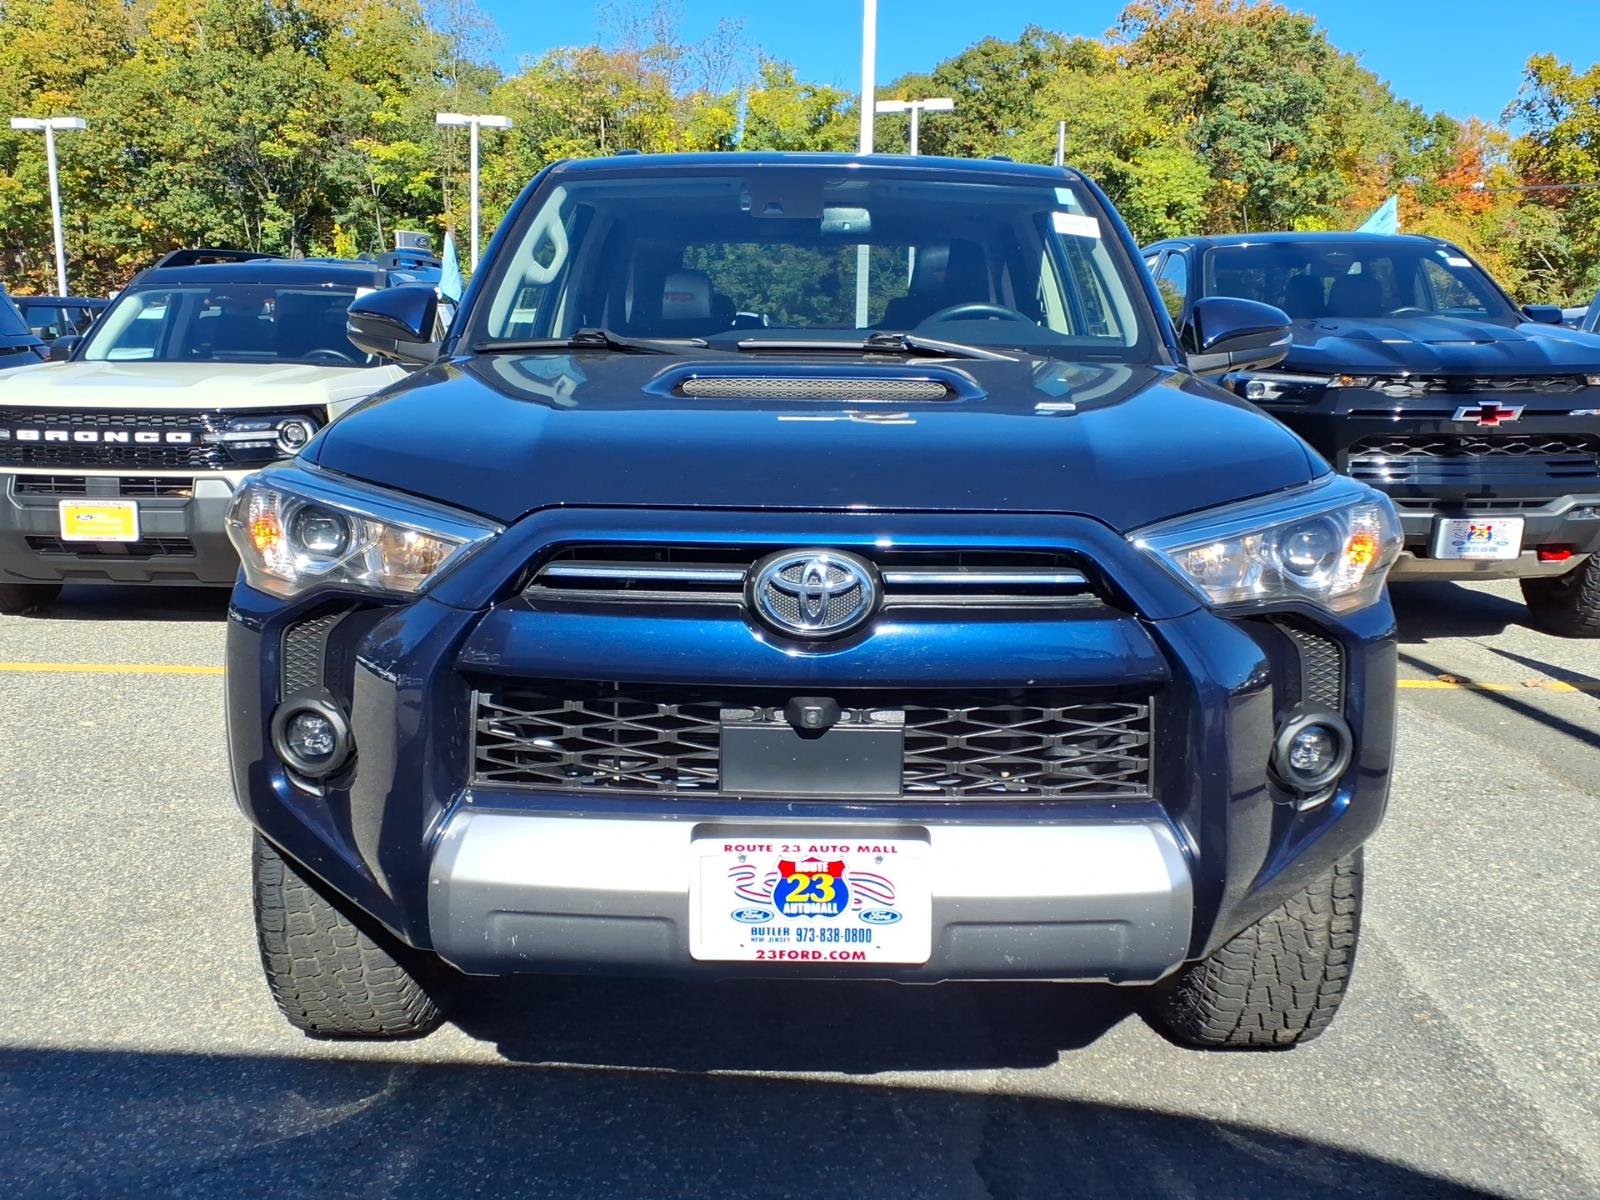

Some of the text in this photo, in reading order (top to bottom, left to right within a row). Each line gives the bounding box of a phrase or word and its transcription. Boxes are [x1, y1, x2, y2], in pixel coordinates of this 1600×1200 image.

[16, 430, 191, 443] BRONCO
[1472, 529, 1489, 539] 23
[724, 844, 773, 852] ROUTE
[808, 845, 850, 853] AUTO
[857, 846, 898, 854] MALL
[795, 861, 829, 872] ROUTE
[785, 873, 836, 903] 23
[751, 927, 872, 943] BUTLER 973-838-0800
[756, 950, 866, 960] 23FORD.COM
